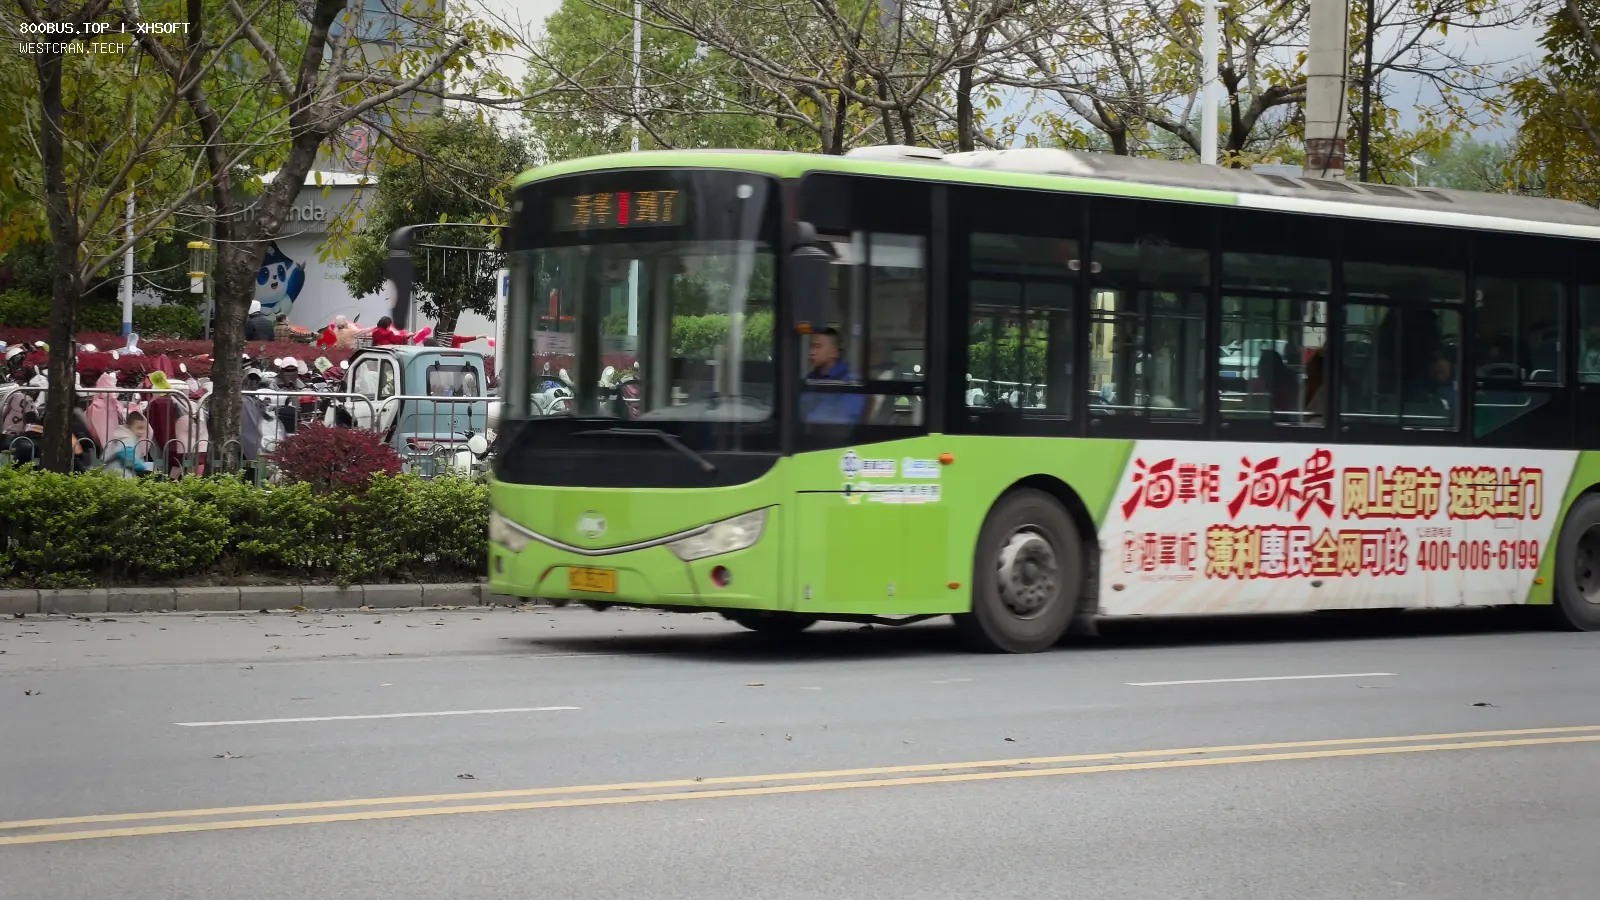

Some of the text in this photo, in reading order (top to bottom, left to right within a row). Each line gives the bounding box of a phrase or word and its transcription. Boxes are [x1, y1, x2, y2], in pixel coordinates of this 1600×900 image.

[1121, 448, 1543, 521] 酒掌柜 酒不贵 网上超市 送货上门
[1205, 523, 1408, 580] 薄利惠民全网可比
[1417, 539, 1539, 571] 400-006-6199
